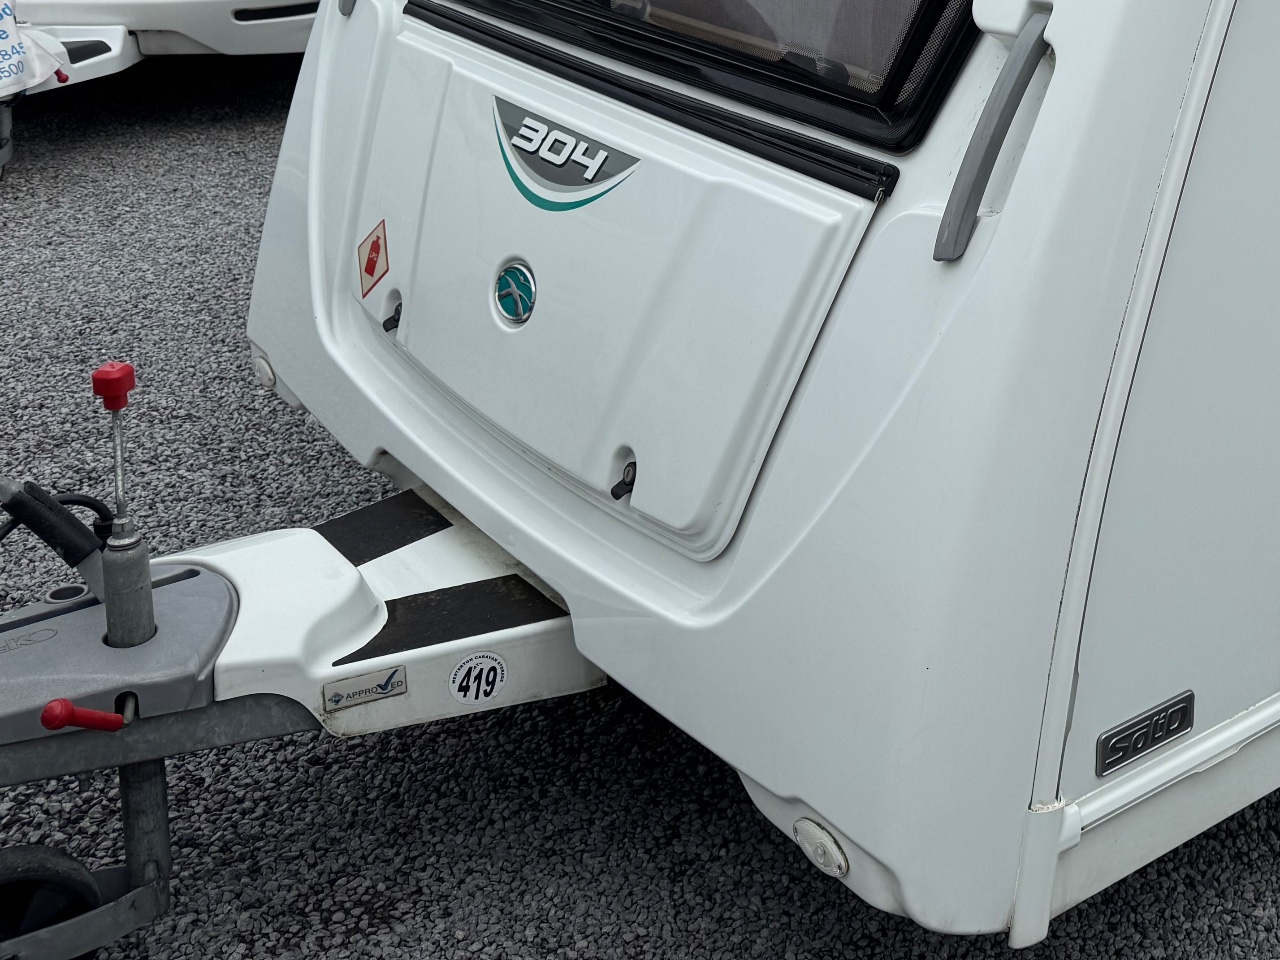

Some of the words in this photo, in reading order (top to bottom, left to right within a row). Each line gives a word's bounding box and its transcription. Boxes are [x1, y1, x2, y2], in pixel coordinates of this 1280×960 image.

[0, 60, 24, 81] 500
[511, 116, 609, 182] 304
[457, 666, 498, 701] 419
